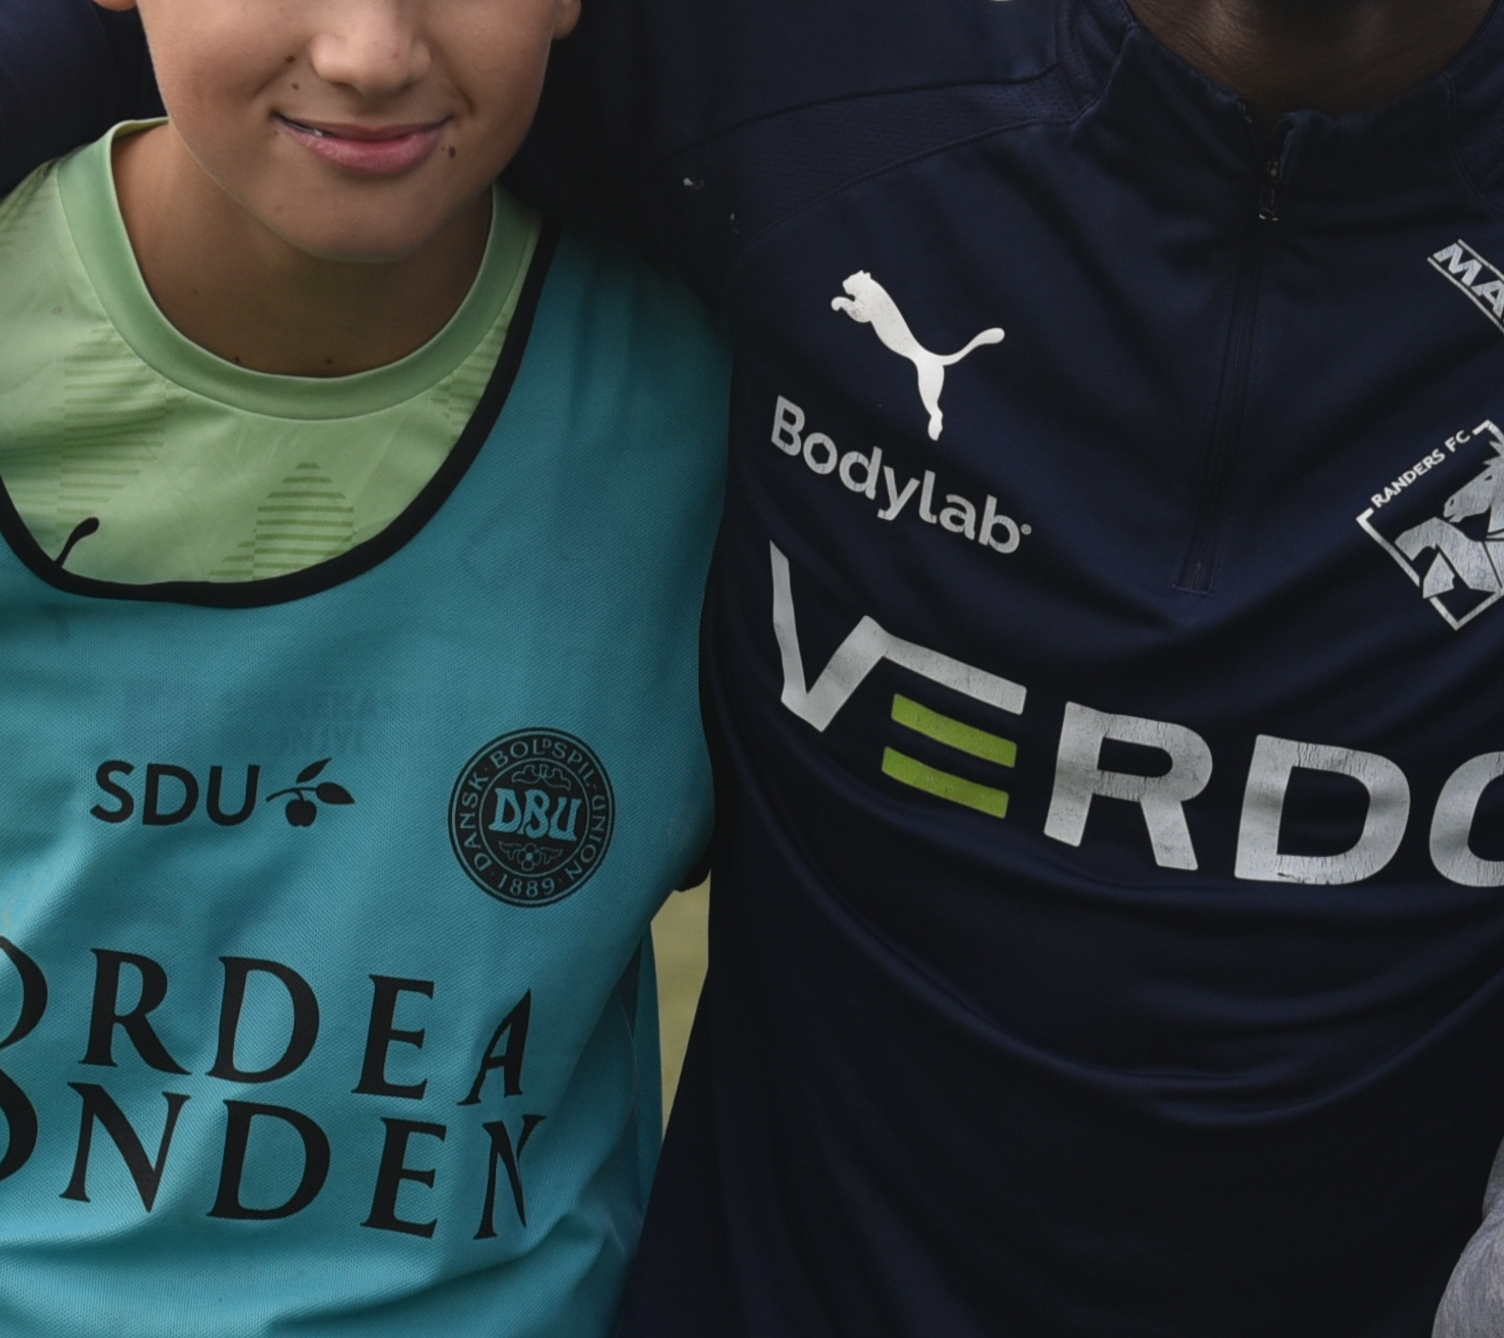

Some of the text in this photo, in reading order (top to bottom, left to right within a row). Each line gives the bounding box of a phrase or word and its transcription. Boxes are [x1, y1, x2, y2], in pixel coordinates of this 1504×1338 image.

[1371, 430, 1471, 508] RANDERS FC
[90, 757, 261, 827] SDU
[460, 772, 493, 871] DANSK
[488, 787, 582, 842] DBU
[497, 873, 556, 898] 1889
